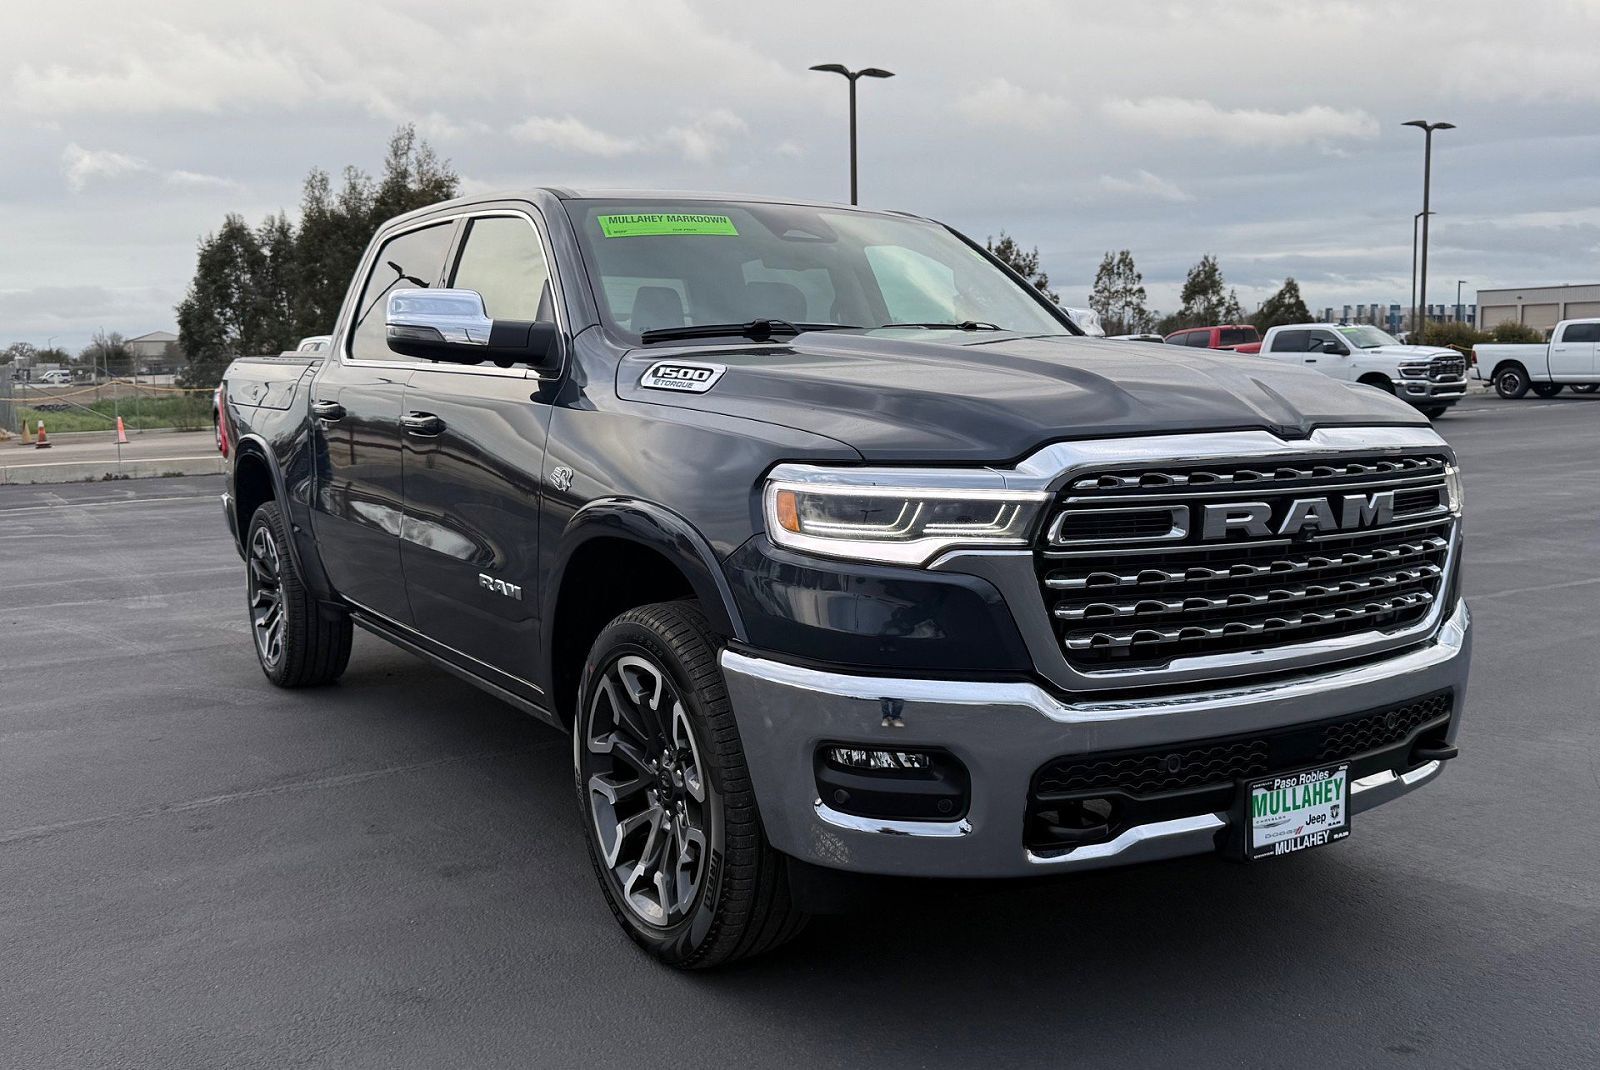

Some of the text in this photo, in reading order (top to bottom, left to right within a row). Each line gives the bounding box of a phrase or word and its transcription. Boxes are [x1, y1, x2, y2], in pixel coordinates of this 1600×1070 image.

[608, 215, 727, 224] MULLAHEY MARKDOWN
[656, 366, 712, 381] 1500
[1202, 490, 1395, 540] RAM
[478, 572, 523, 600] RAM
[1273, 777, 1297, 790] Paso
[1299, 770, 1330, 785] Robles
[1252, 777, 1344, 818] MULLAHEY
[1305, 813, 1327, 826] Jeep
[1274, 830, 1330, 856] MULLAHEY
